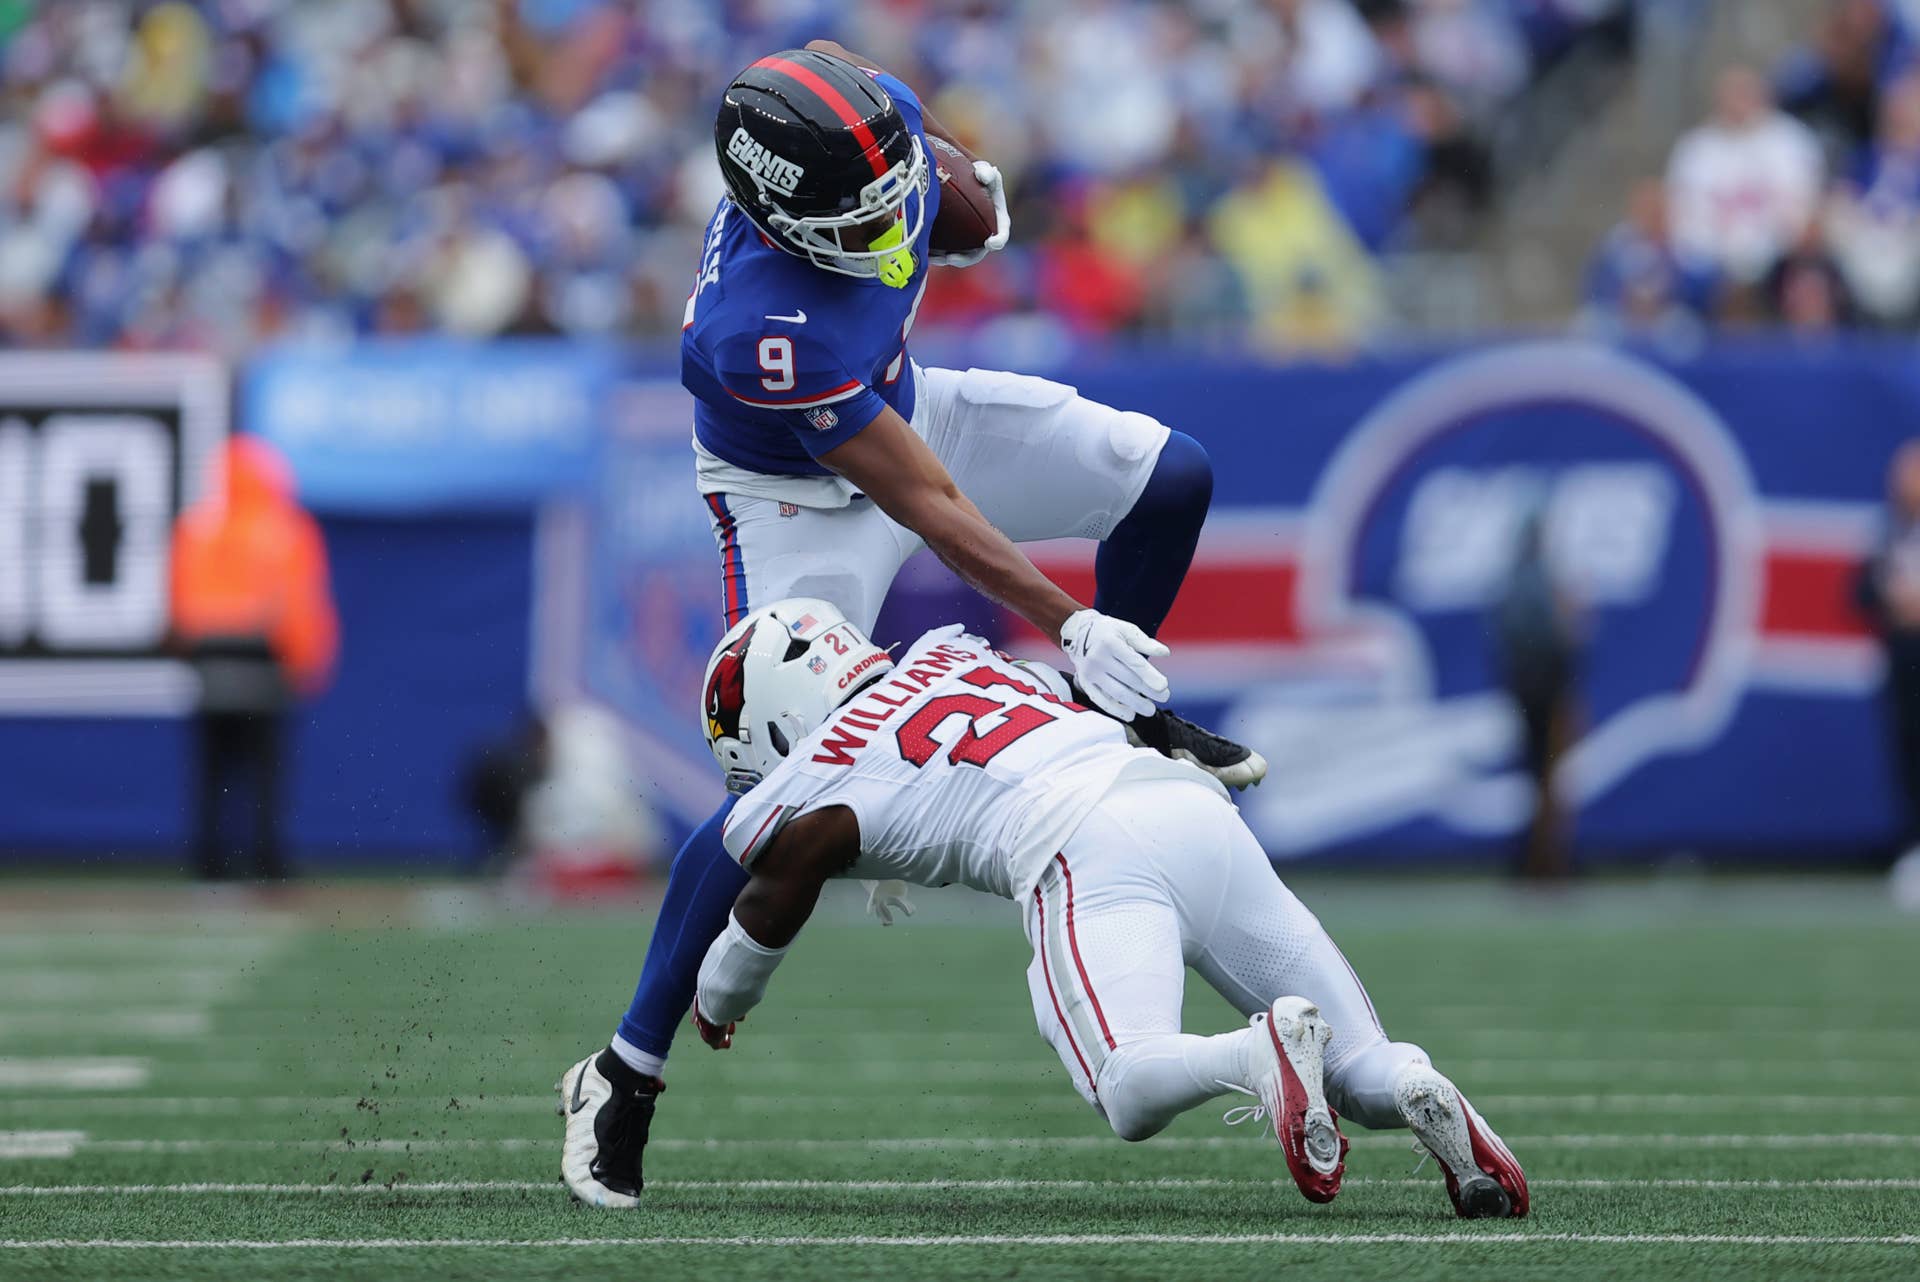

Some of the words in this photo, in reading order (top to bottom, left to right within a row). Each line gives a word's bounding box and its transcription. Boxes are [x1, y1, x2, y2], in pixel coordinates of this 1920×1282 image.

[728, 127, 804, 191] GIANTS
[756, 335, 796, 391] 9
[811, 644, 978, 766] WILLIAMS
[895, 665, 1090, 769] 21
